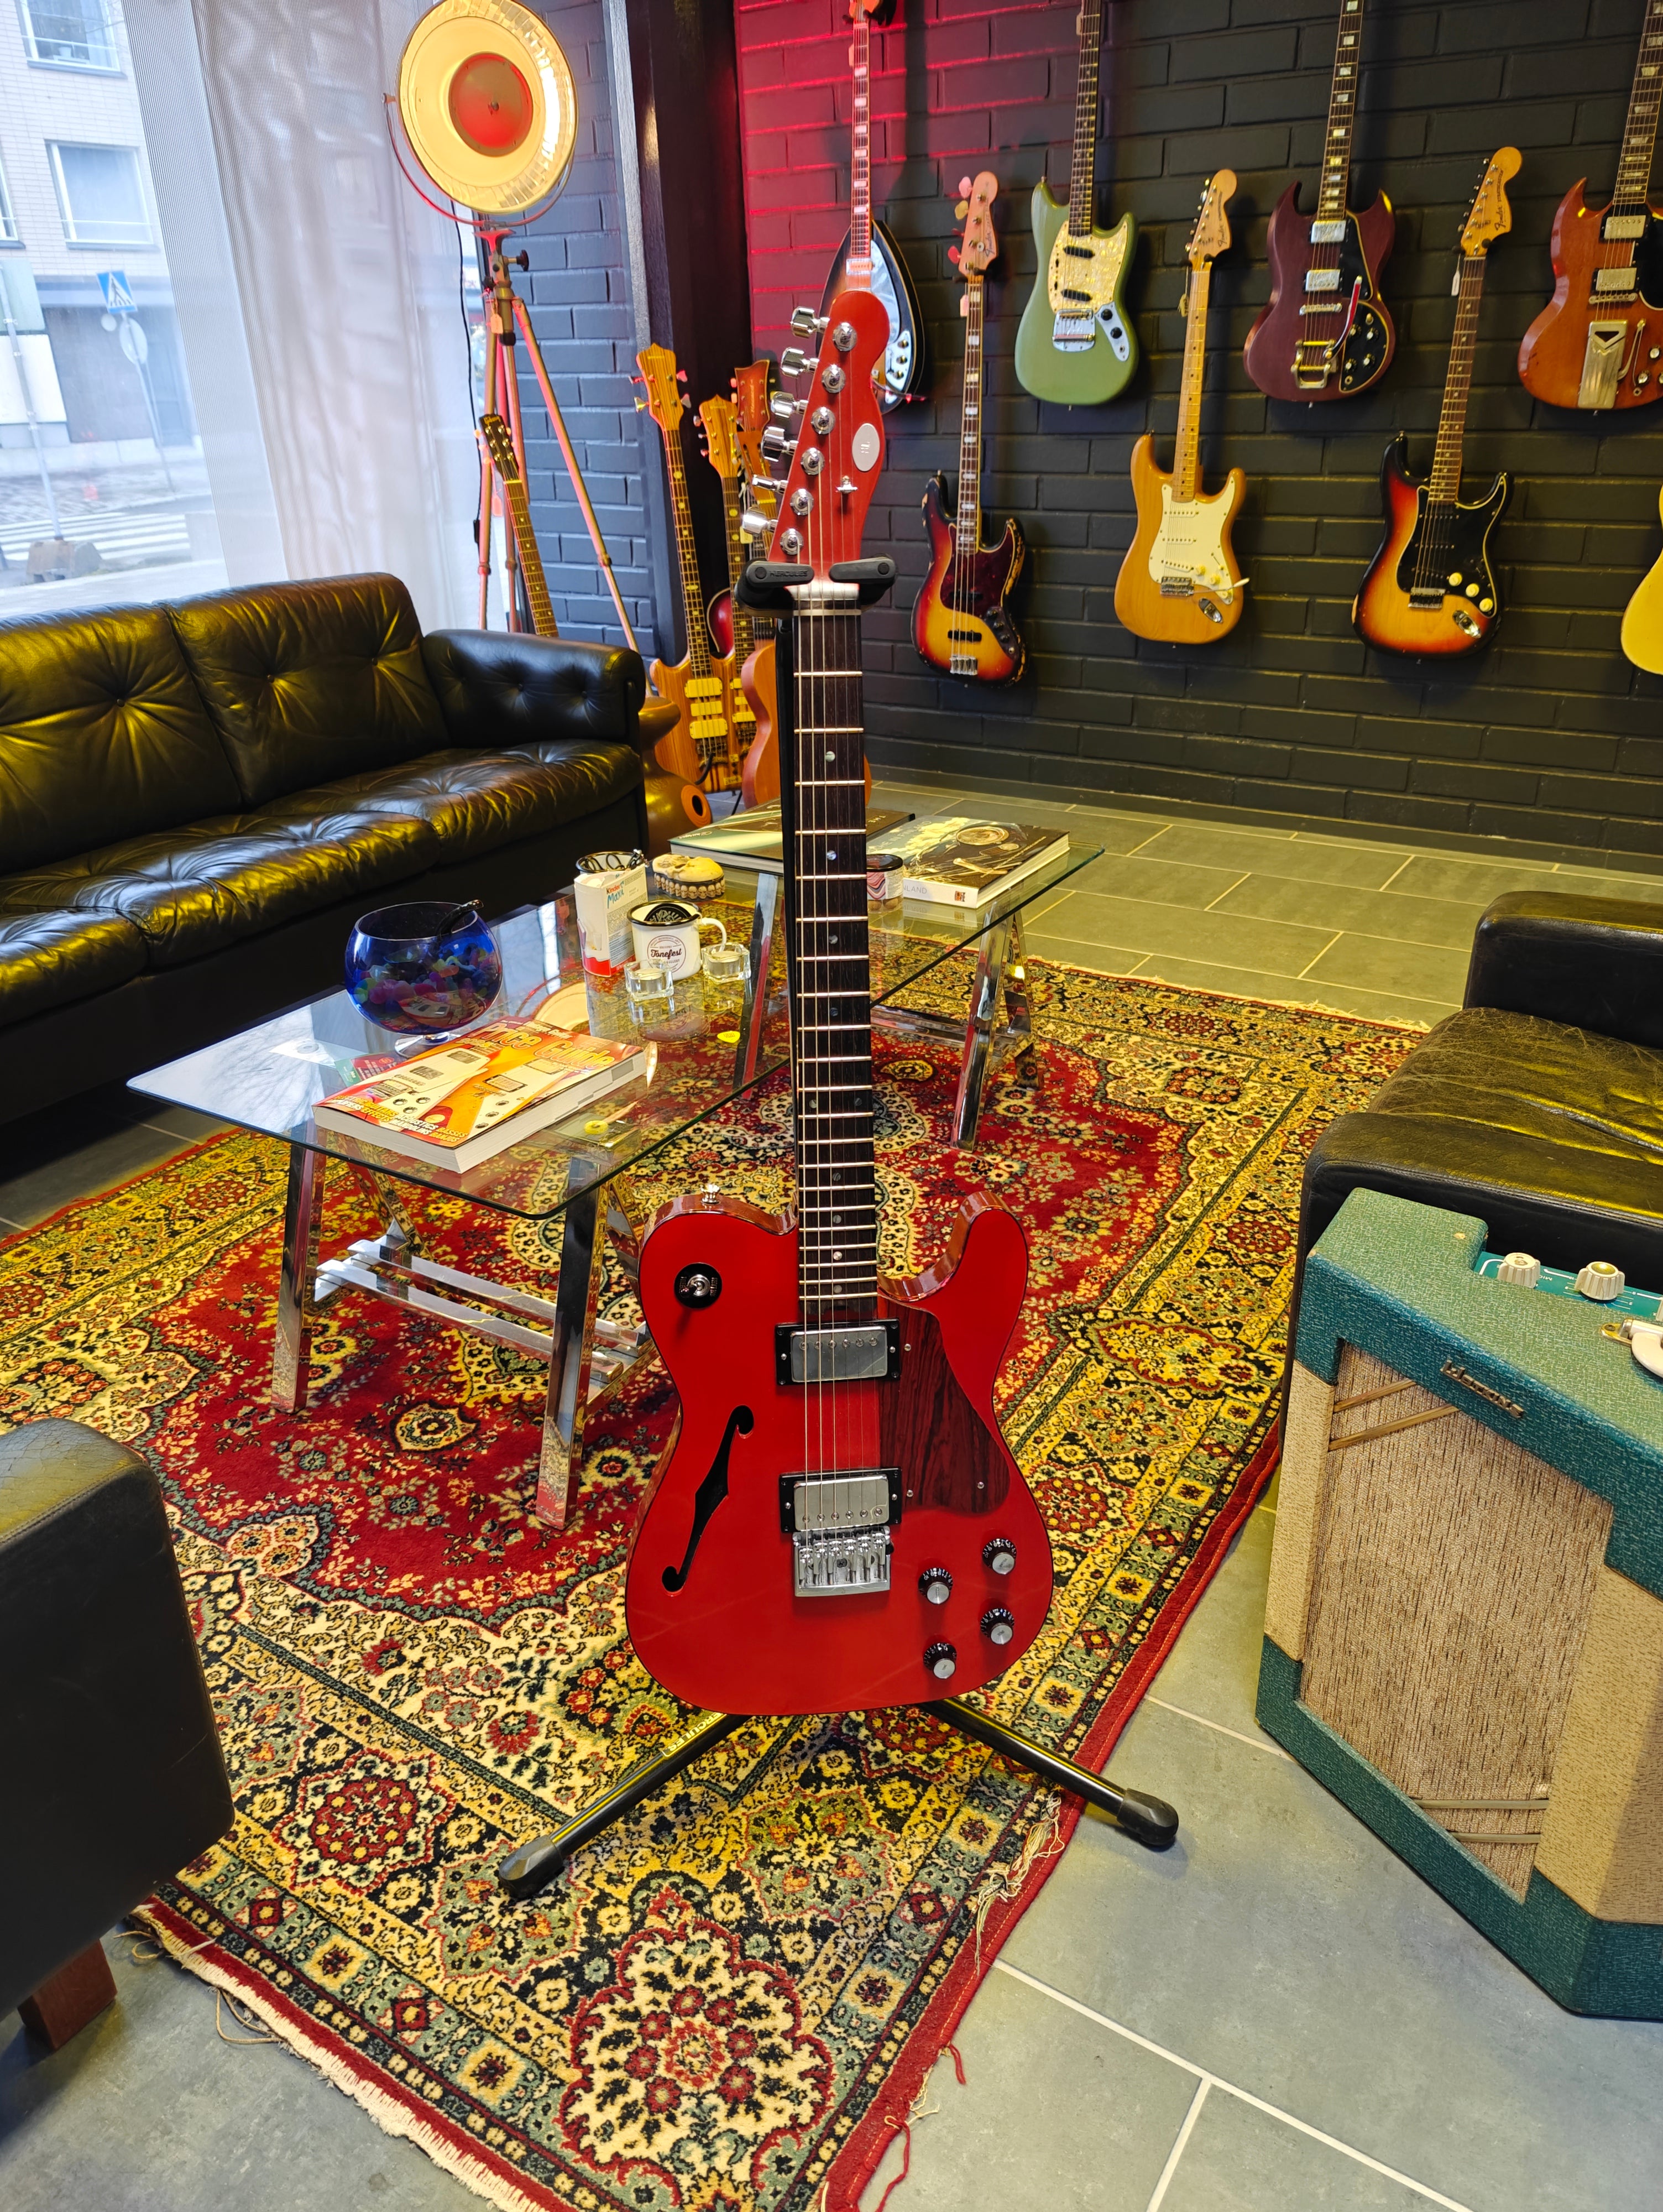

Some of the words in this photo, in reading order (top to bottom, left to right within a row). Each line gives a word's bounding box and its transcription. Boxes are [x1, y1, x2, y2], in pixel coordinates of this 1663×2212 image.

[651, 948, 682, 959] Tonefest
[467, 1022, 542, 1050] Price
[534, 1040, 615, 1070] Guide
[360, 1106, 393, 1123] EFFECTS
[389, 1118, 432, 1135] MANDOLINS
[429, 1131, 460, 1142] BANJOS
[365, 1102, 399, 1117] GUITARS
[395, 1114, 439, 1130] ACOUSTICS
[436, 1126, 469, 1138] BASSES
[668, 1712, 724, 1751] ERCULES
